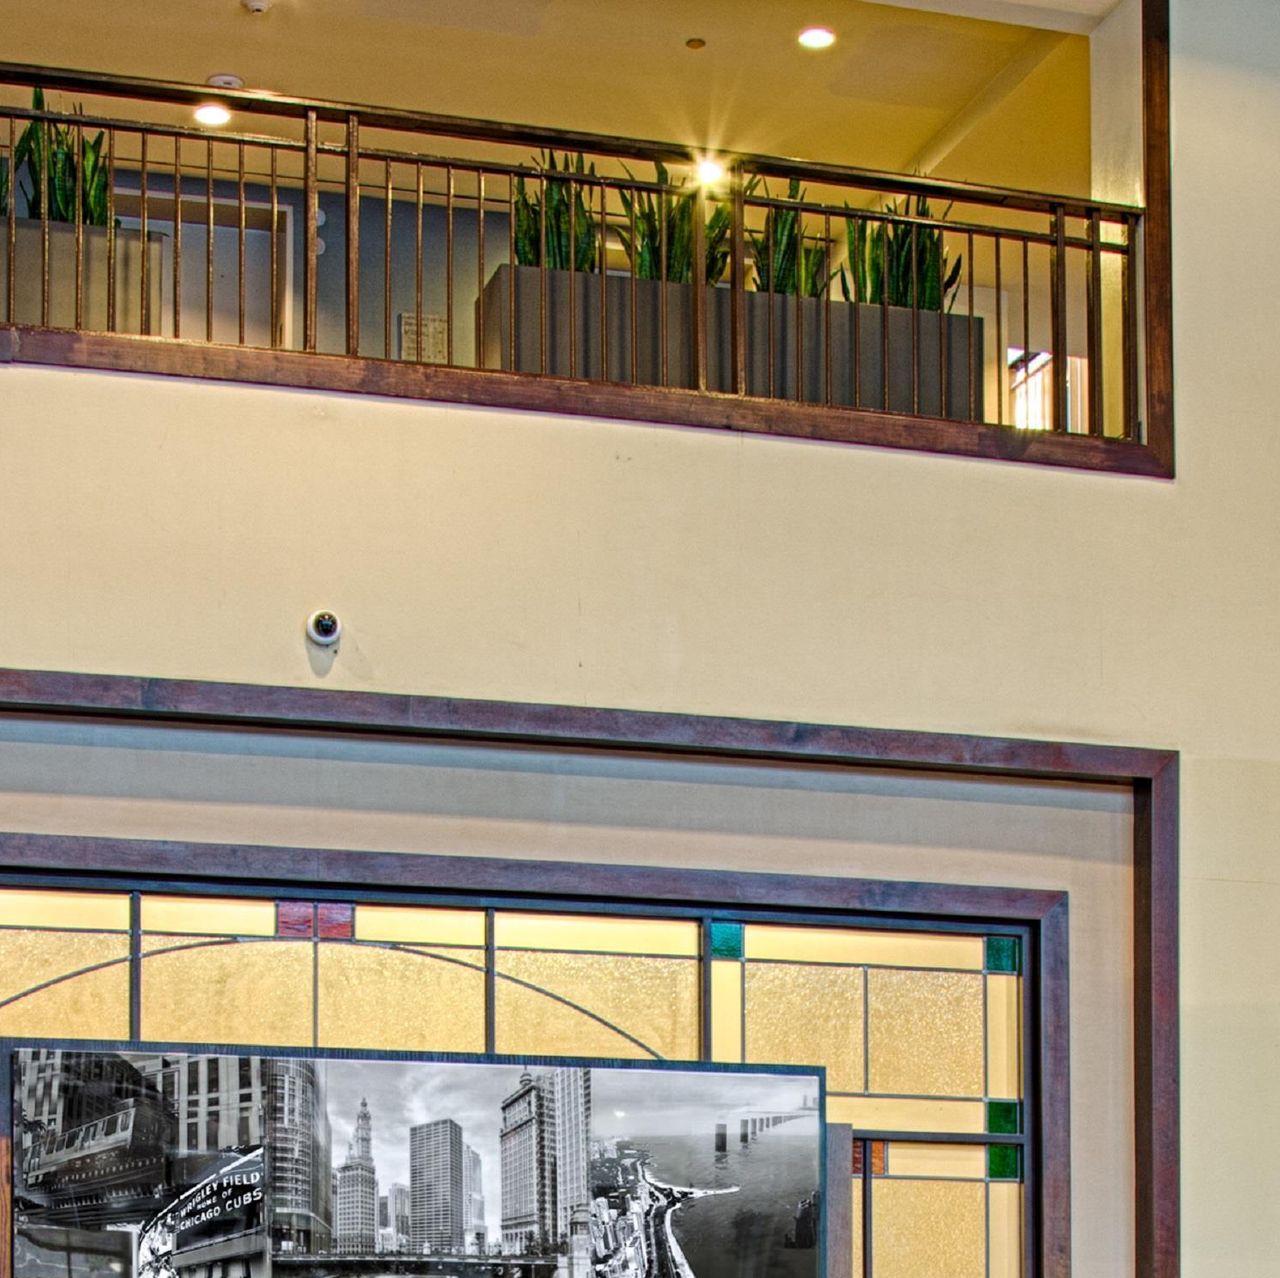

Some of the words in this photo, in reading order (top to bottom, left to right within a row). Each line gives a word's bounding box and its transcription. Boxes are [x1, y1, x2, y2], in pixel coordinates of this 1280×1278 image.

[180, 1180, 219, 1218] WRIGLEY
[223, 1172, 260, 1187] FIELD
[180, 1206, 221, 1231] CHICAGO
[225, 1187, 263, 1211] CUBS
[196, 1195, 218, 1210] HOME
[221, 1188, 232, 1199] OF
